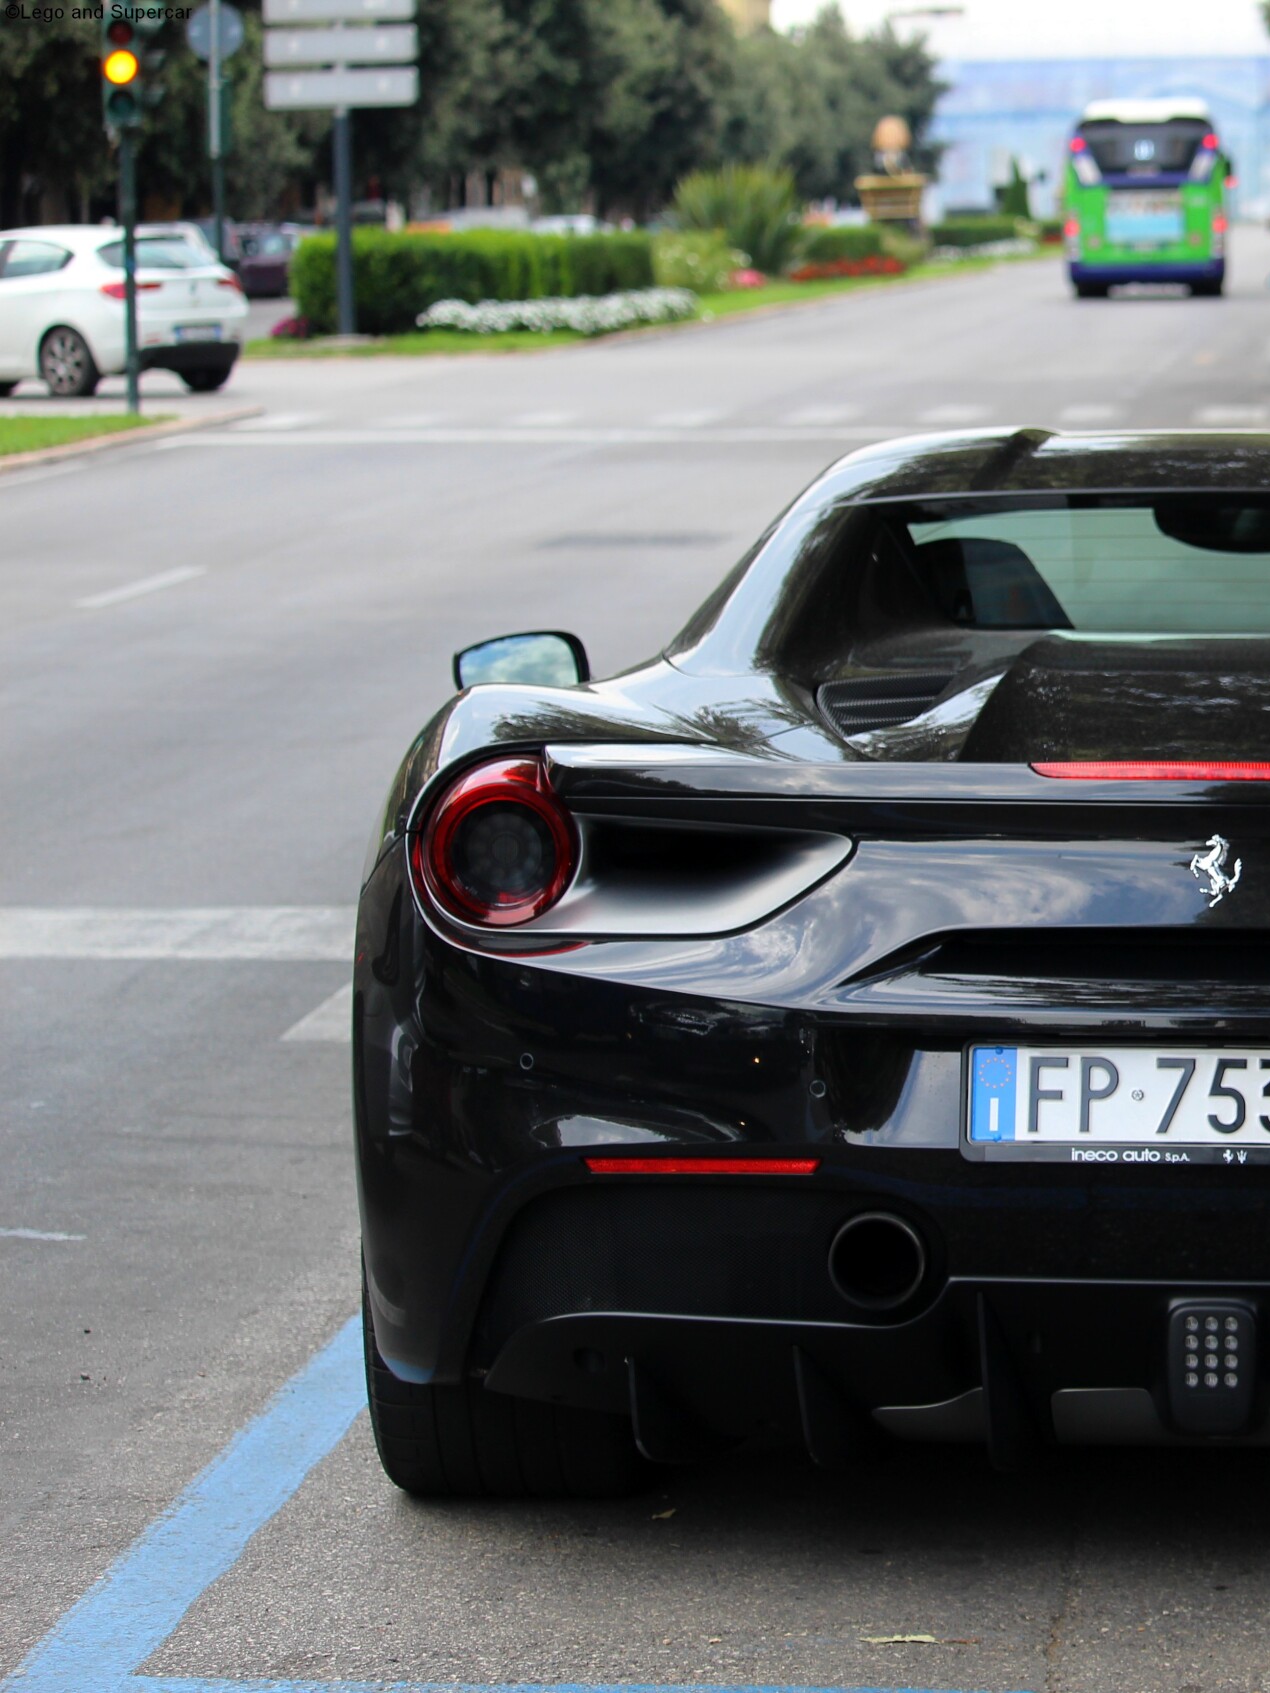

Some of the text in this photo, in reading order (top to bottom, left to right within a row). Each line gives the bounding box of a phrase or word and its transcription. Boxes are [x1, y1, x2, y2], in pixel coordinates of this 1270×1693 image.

[1028, 1056, 1119, 1133] FP
[1071, 1147, 1118, 1162] ineco
[1122, 1148, 1160, 1162] auto
